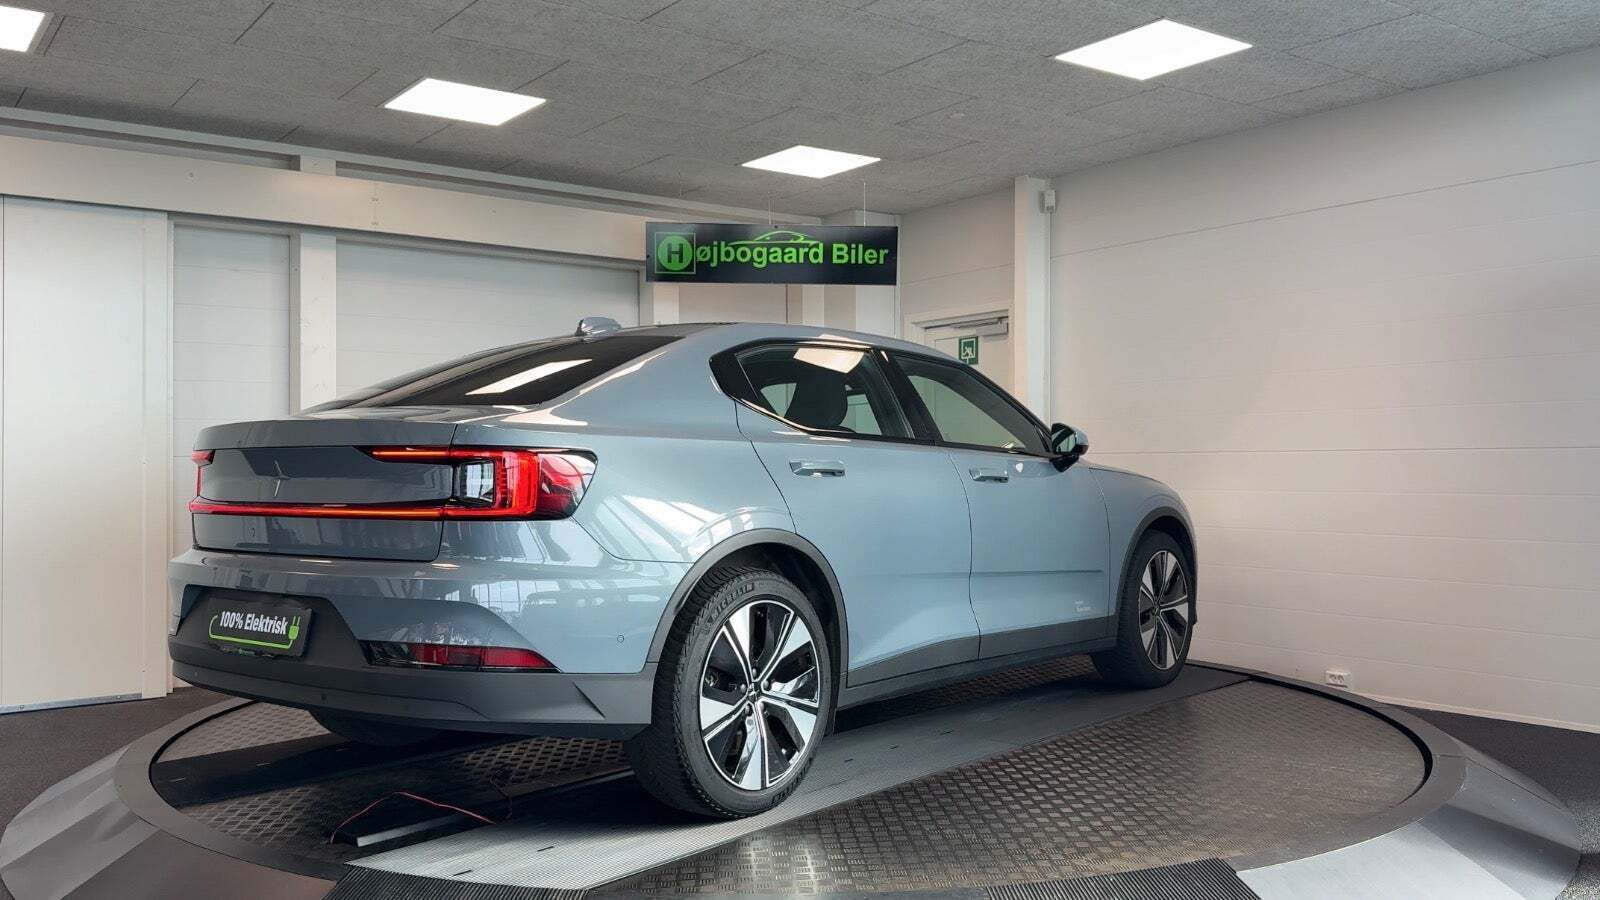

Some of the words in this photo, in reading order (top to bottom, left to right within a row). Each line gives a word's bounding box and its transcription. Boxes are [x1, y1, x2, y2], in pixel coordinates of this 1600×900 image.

[832, 243, 888, 265] Biler
[219, 611, 243, 630] 100%
[244, 613, 288, 635] Elektrisk
